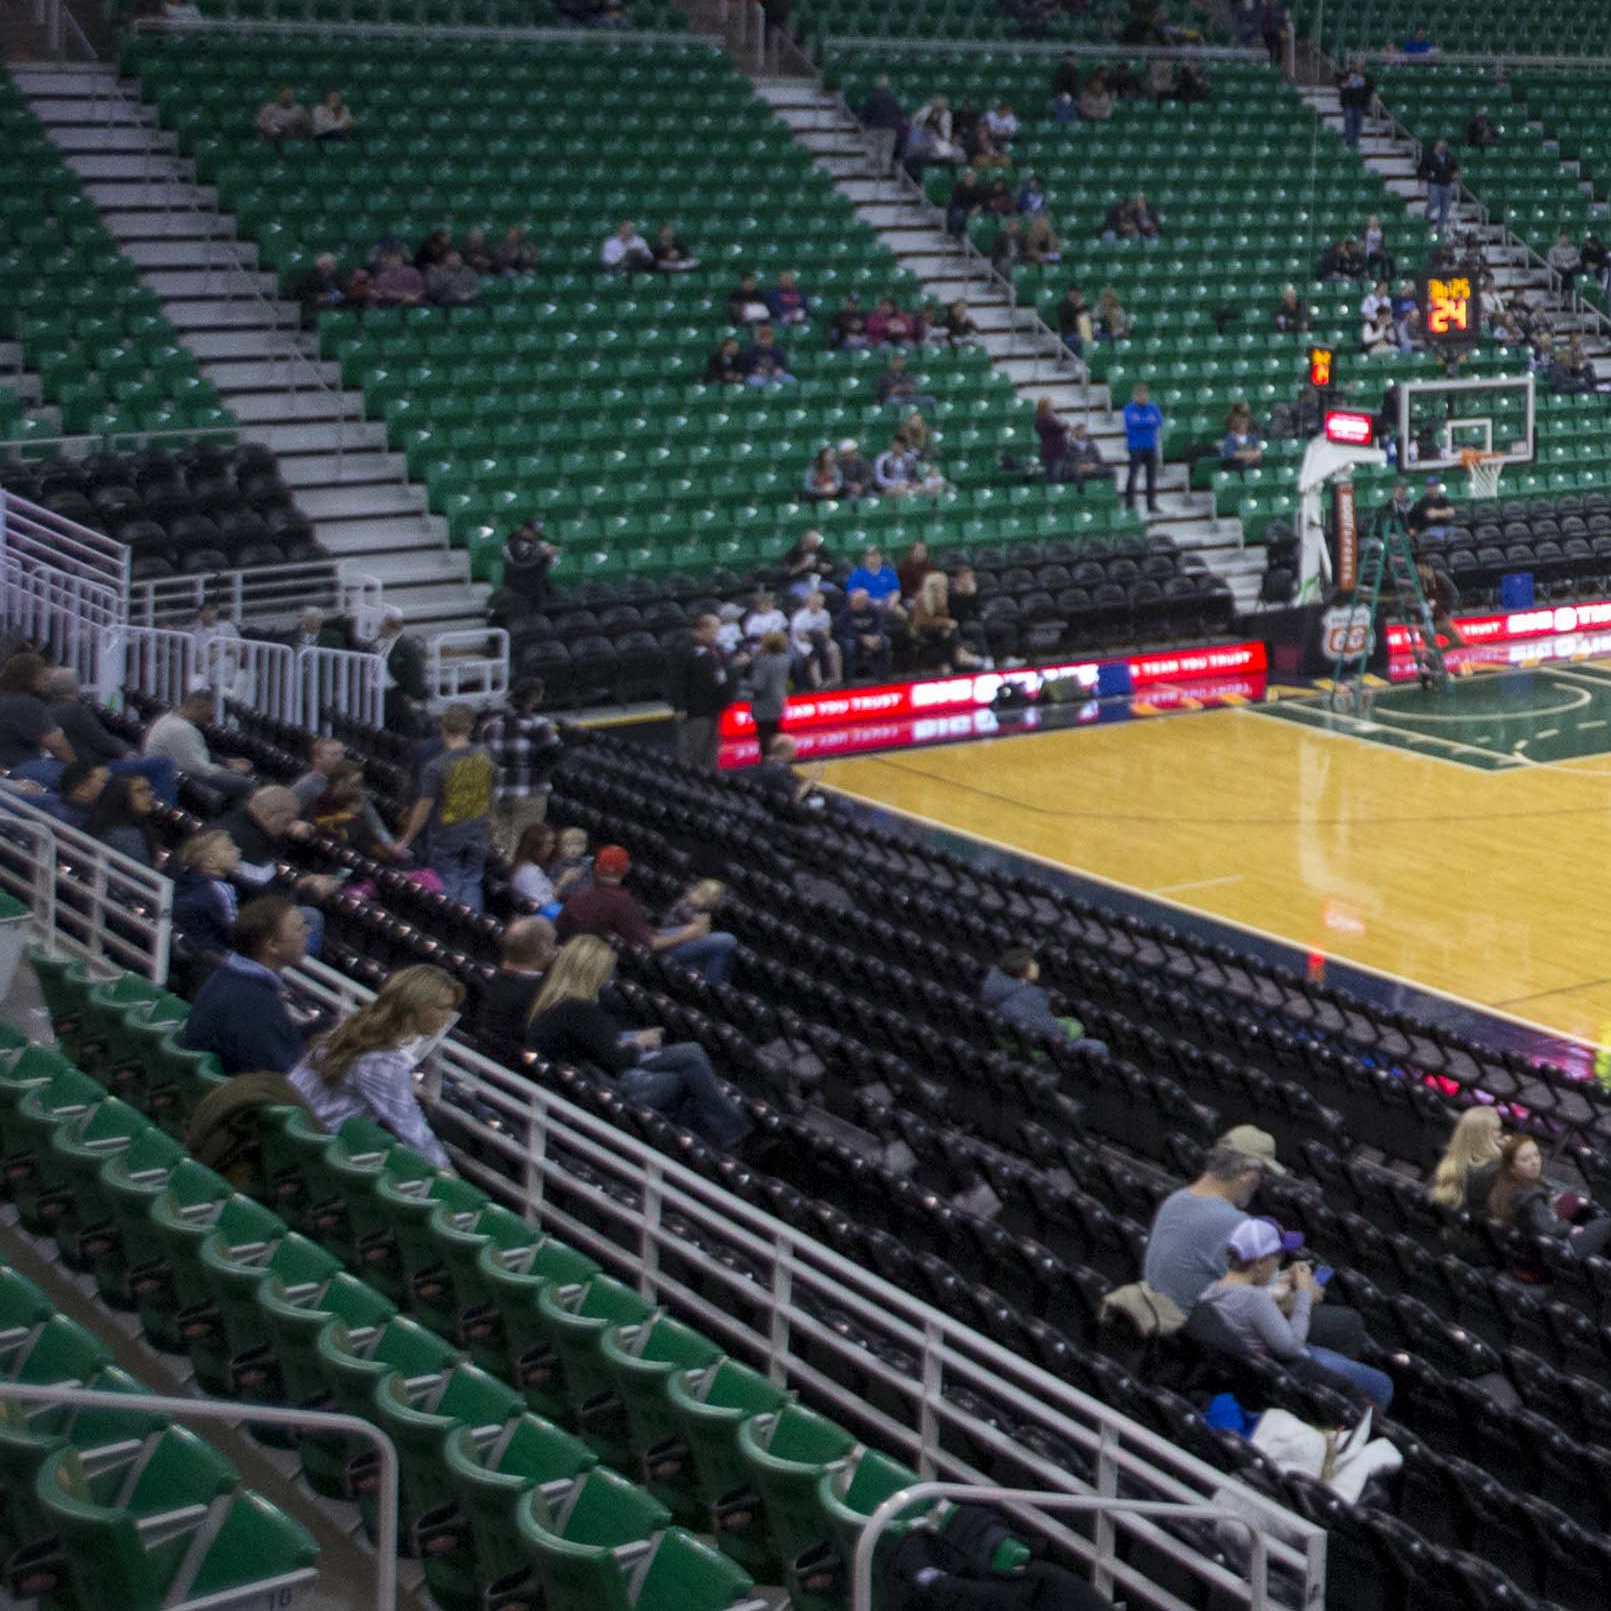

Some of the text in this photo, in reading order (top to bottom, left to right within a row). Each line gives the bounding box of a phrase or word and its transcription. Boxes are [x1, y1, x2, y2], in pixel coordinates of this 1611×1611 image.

[1428, 297, 1467, 334] 24
[1462, 622, 1502, 635] TRUST
[816, 699, 850, 716] YOU
[849, 692, 904, 710] TRUST
[1142, 660, 1179, 674] TEAM
[1179, 656, 1208, 671] YOU
[1208, 651, 1253, 668] TRUST
